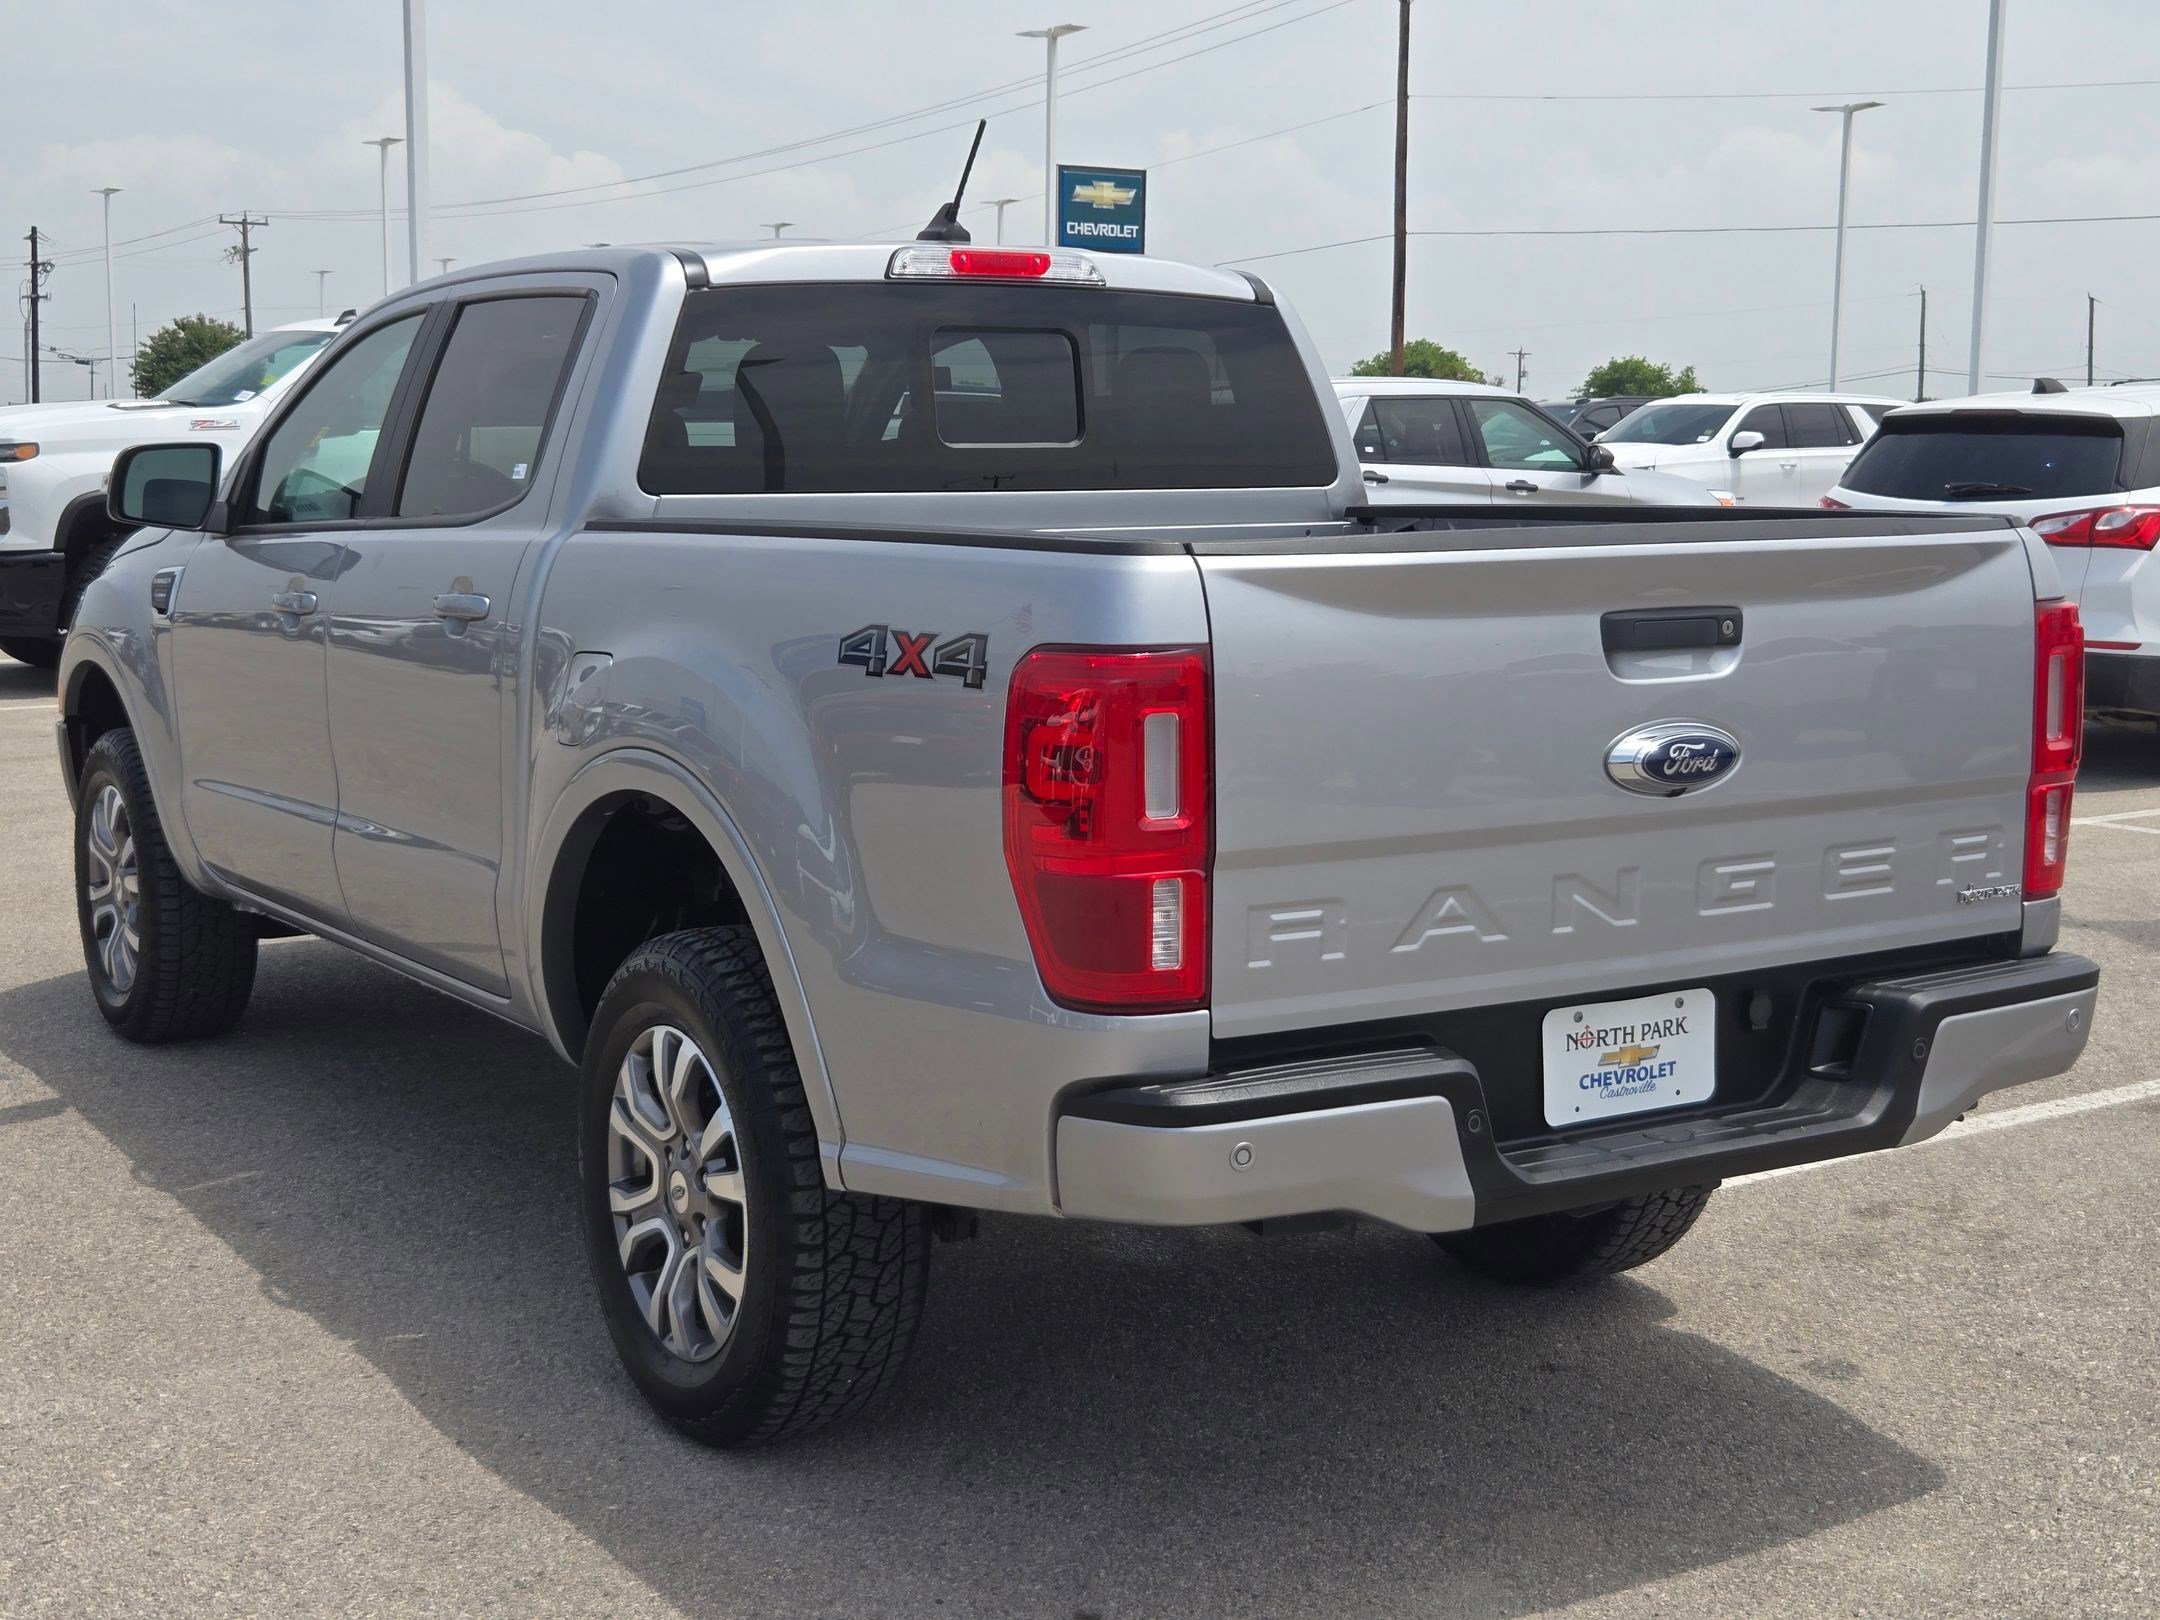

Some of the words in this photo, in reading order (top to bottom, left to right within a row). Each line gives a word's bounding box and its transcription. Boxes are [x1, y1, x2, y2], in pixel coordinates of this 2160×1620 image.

[1066, 221, 1139, 238] CHEVROLET
[1664, 743, 1719, 775] Ford
[1245, 823, 2004, 968] RANGER
[1566, 1025, 1635, 1051] NORTH
[1641, 1016, 1689, 1041] PARK
[1579, 1060, 1677, 1090] CHEVROLET
[1600, 1080, 1656, 1099] Castroville
